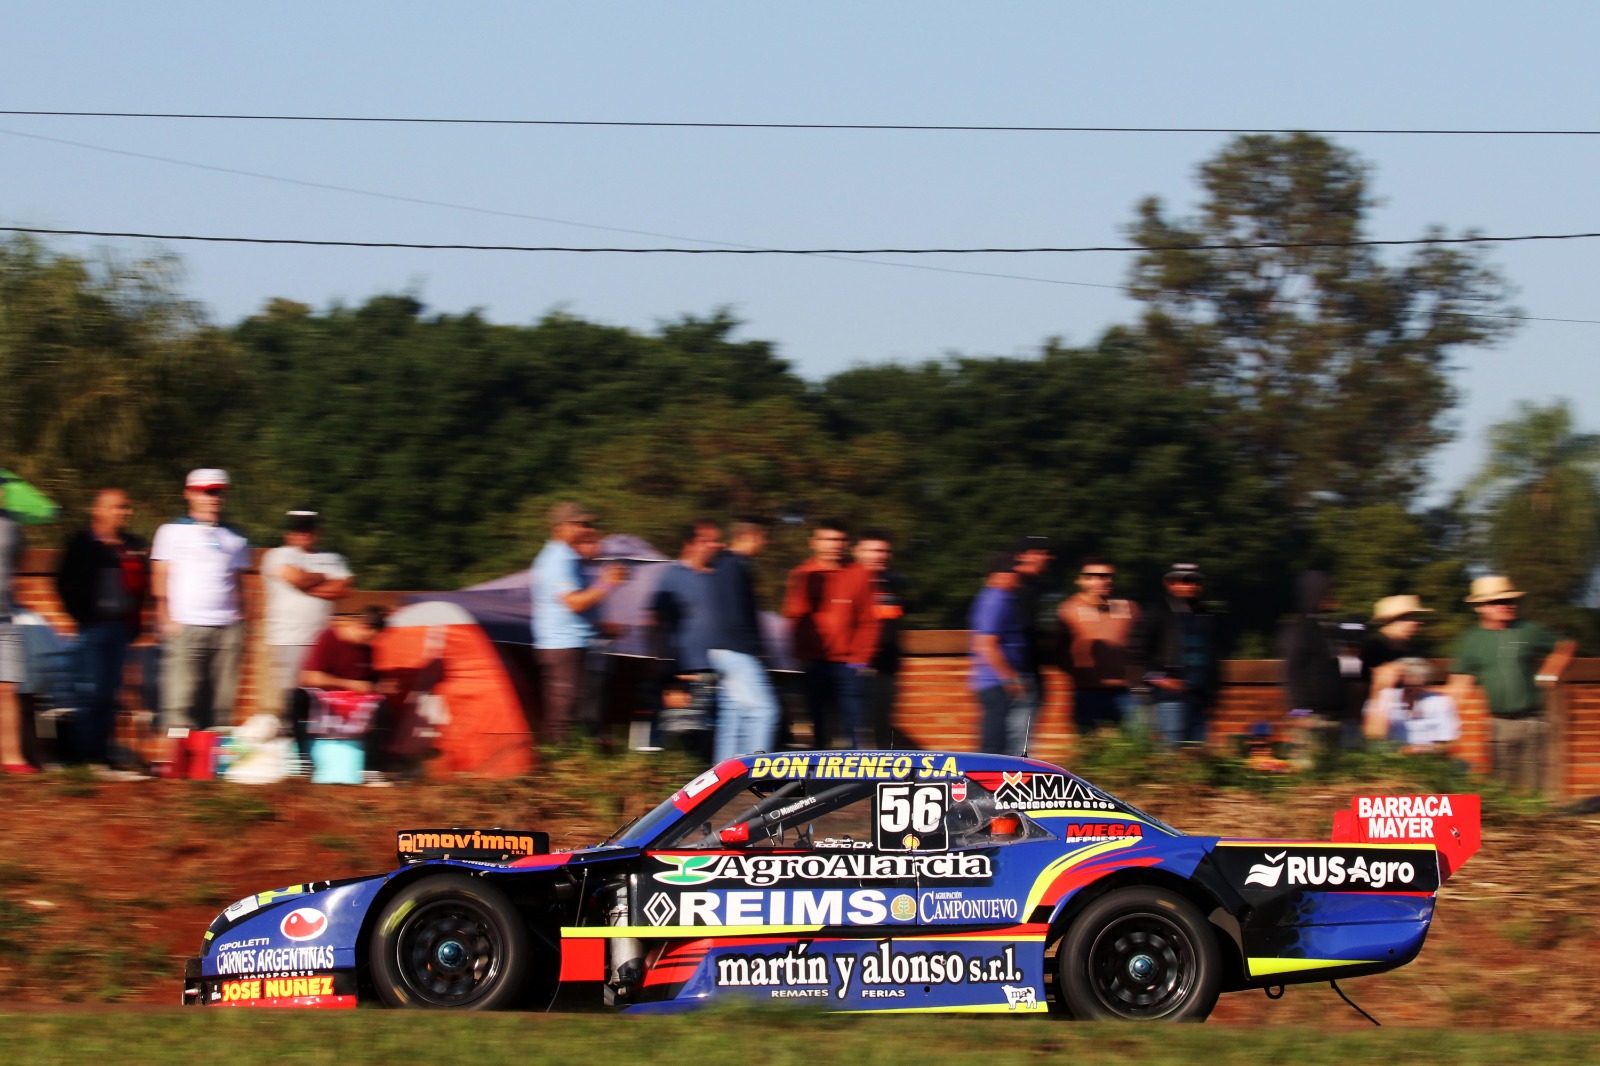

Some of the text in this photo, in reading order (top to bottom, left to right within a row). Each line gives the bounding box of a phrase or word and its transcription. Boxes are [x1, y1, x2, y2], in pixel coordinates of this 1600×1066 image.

[751, 756, 965, 778] DON IRENEO S.A.
[880, 786, 943, 833] 56
[1358, 796, 1453, 818] BARRACA
[1066, 823, 1143, 837] MEGA
[1368, 817, 1435, 838] MAYER
[714, 851, 993, 887] AgroAlarcia
[680, 889, 888, 927] REIMS
[920, 890, 1019, 923] CAMPONUEVO
[219, 937, 270, 952] CIPOLLETTI
[216, 945, 335, 975] CARNES ARGENTINAS
[718, 942, 1022, 999] martín y alonso s.r.l.
[223, 980, 261, 1002] JOSE
[771, 989, 829, 998] REMATES
[861, 989, 906, 998] FERIAS
